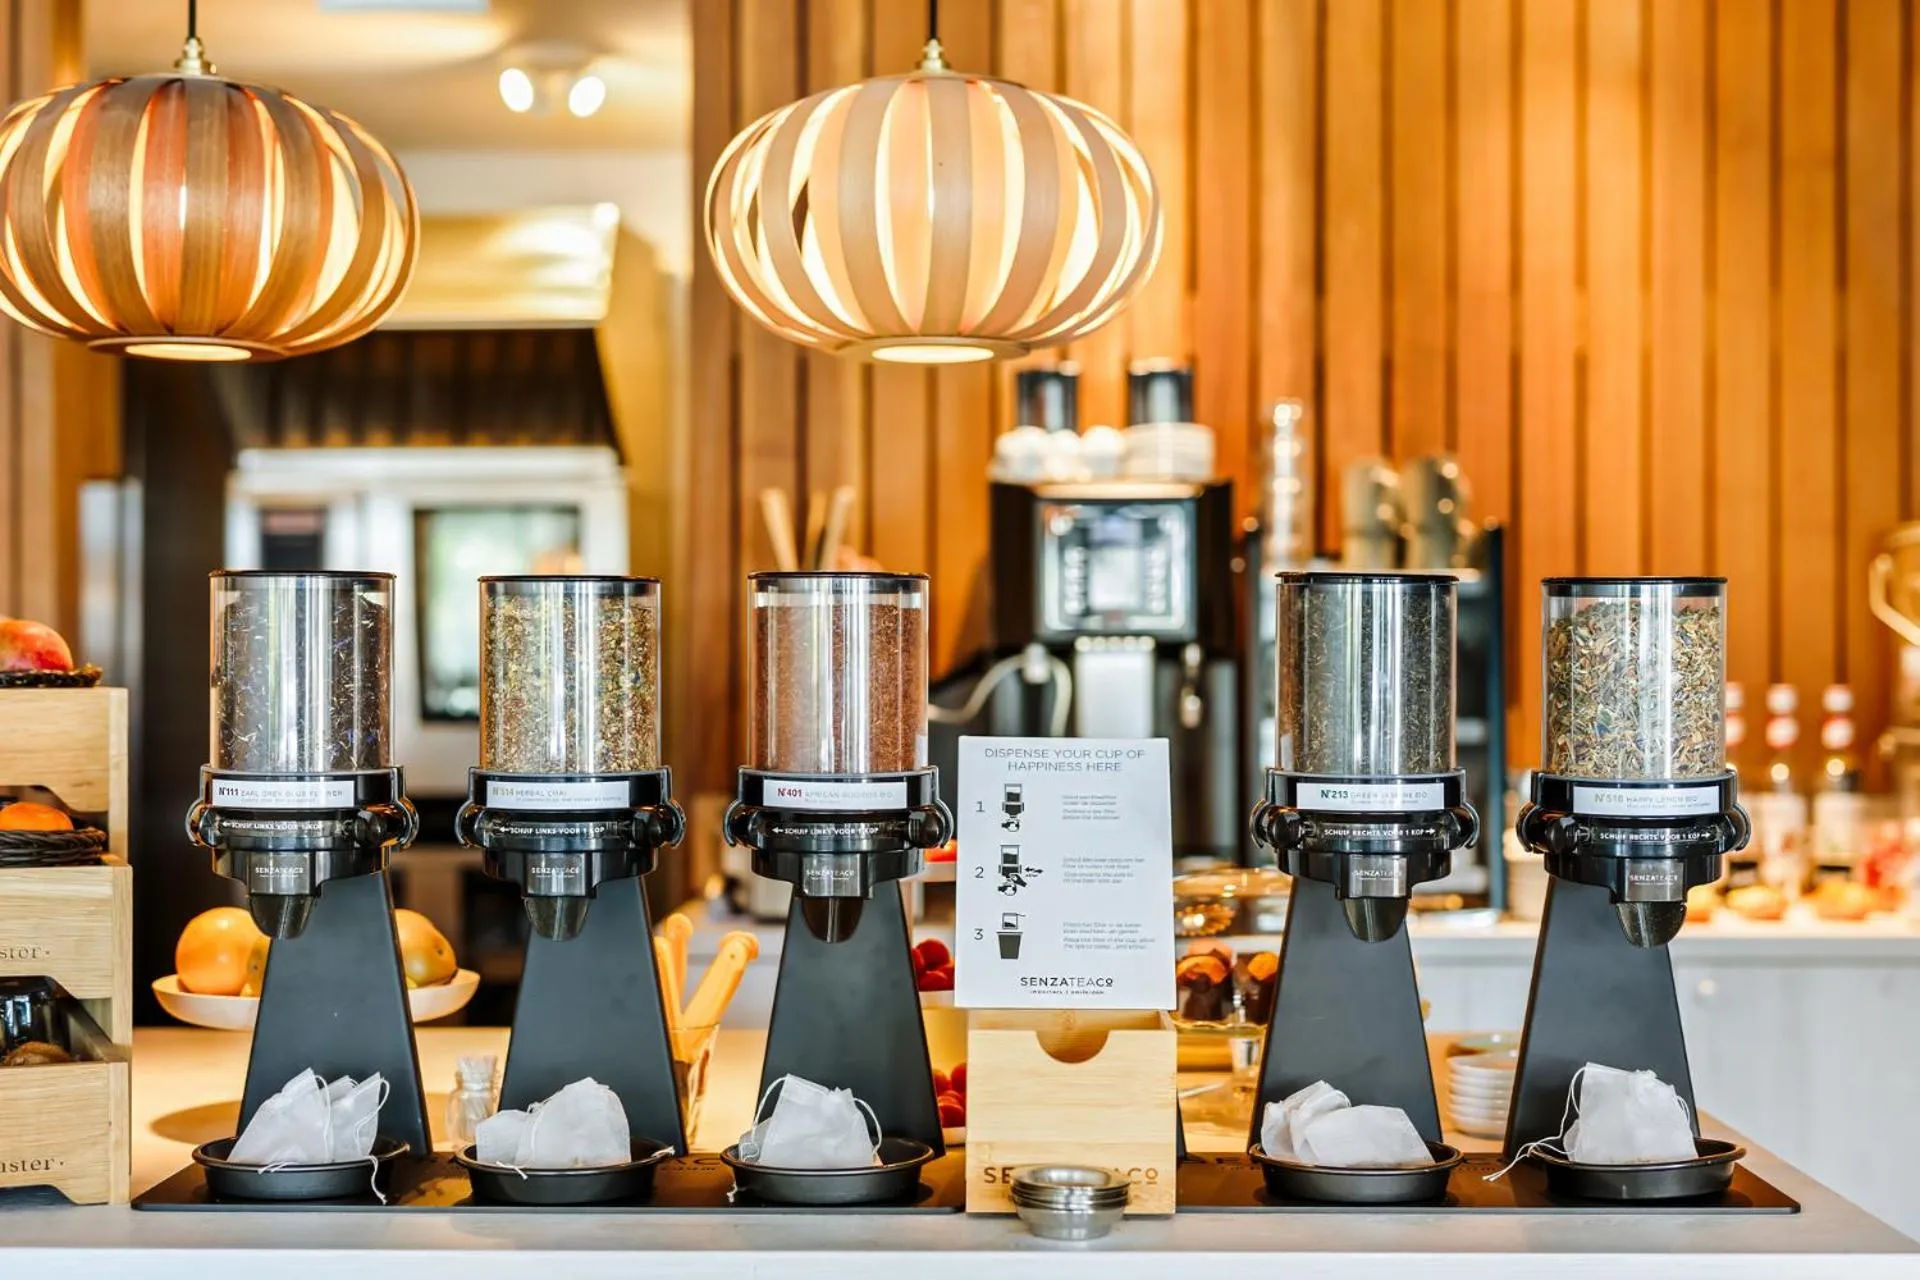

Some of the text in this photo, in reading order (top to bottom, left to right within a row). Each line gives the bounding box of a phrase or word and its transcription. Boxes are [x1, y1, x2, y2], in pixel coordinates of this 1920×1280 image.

[984, 747, 1145, 759] DISPENSE YOUR CUP OF
[1008, 761, 1122, 772] HAPPINESS HERE
[975, 801, 985, 813] 1
[974, 867, 985, 879] 2
[974, 928, 984, 940] 3
